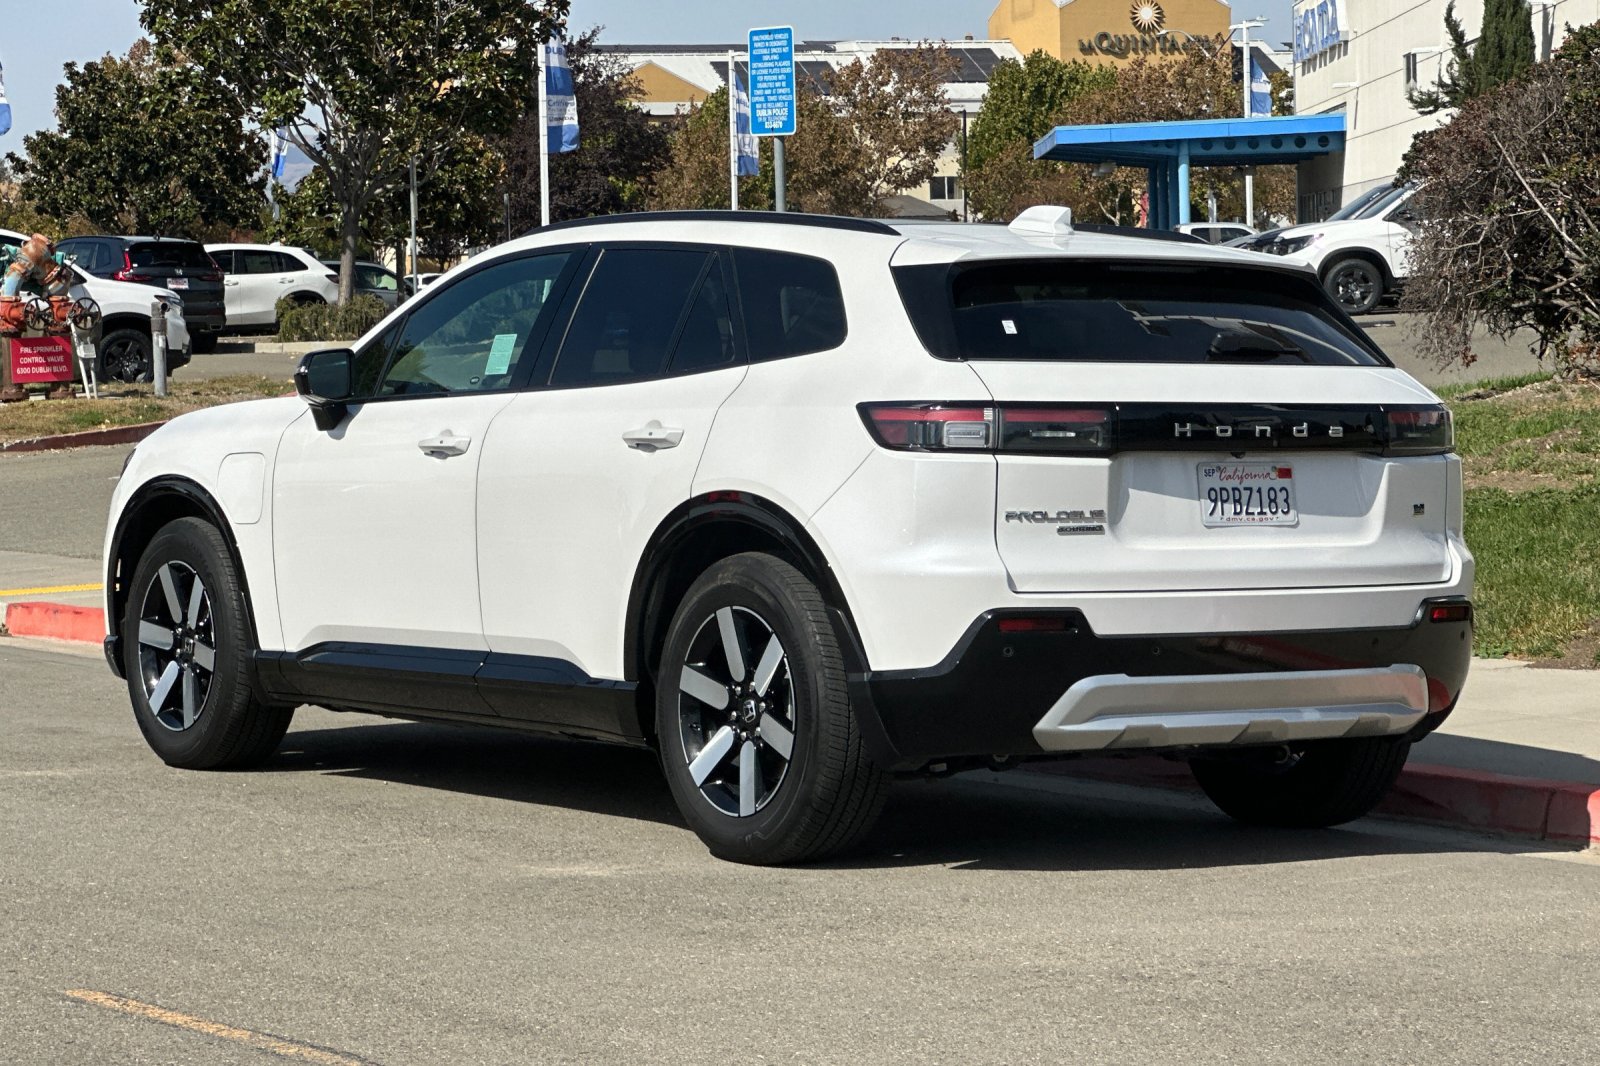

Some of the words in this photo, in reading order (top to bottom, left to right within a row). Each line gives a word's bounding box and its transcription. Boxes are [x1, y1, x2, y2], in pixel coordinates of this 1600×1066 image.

[1094, 31, 1181, 54] QUINTA
[772, 108, 788, 116] POLICE
[20, 346, 33, 354] FIRE
[33, 345, 63, 353] SPRINKLER
[20, 356, 46, 364] CONTROL
[31, 366, 52, 374] DUBLIN
[1204, 468, 1216, 478] SEP
[1219, 465, 1276, 485] California
[1207, 486, 1291, 516] 9PBZ183
[1005, 509, 1107, 523] PROLOGUE
